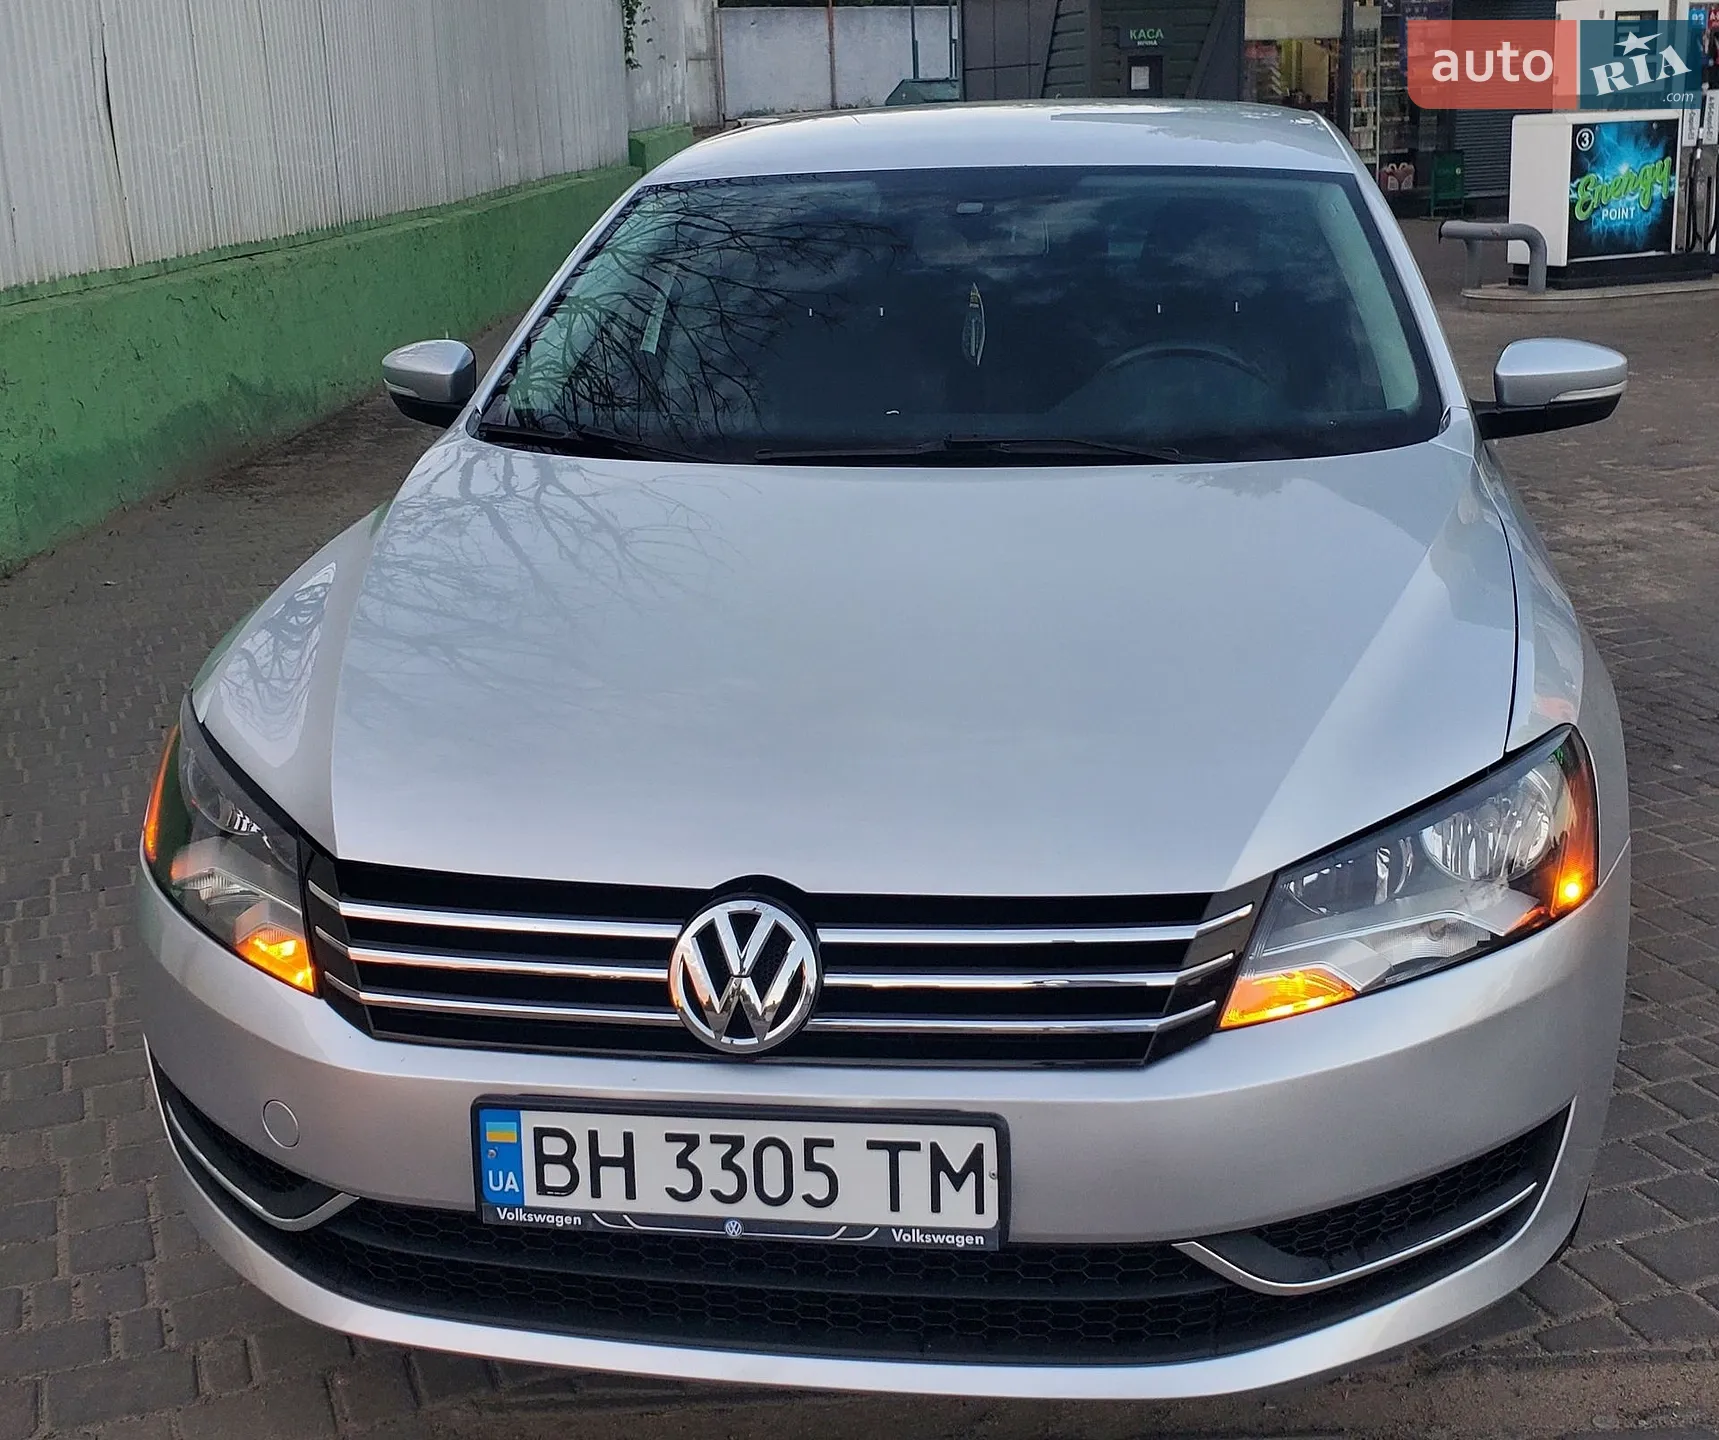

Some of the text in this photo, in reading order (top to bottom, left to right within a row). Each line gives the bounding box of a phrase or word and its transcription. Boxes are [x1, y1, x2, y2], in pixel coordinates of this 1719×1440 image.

[1581, 132, 1590, 148] 3
[1575, 156, 1672, 221] Energy
[1601, 207, 1636, 221] POINT
[488, 1169, 520, 1193] UA
[532, 1126, 986, 1215] BH 3305 TM
[496, 1206, 582, 1227] Volkswagen
[891, 1228, 985, 1248] Volkswagen
